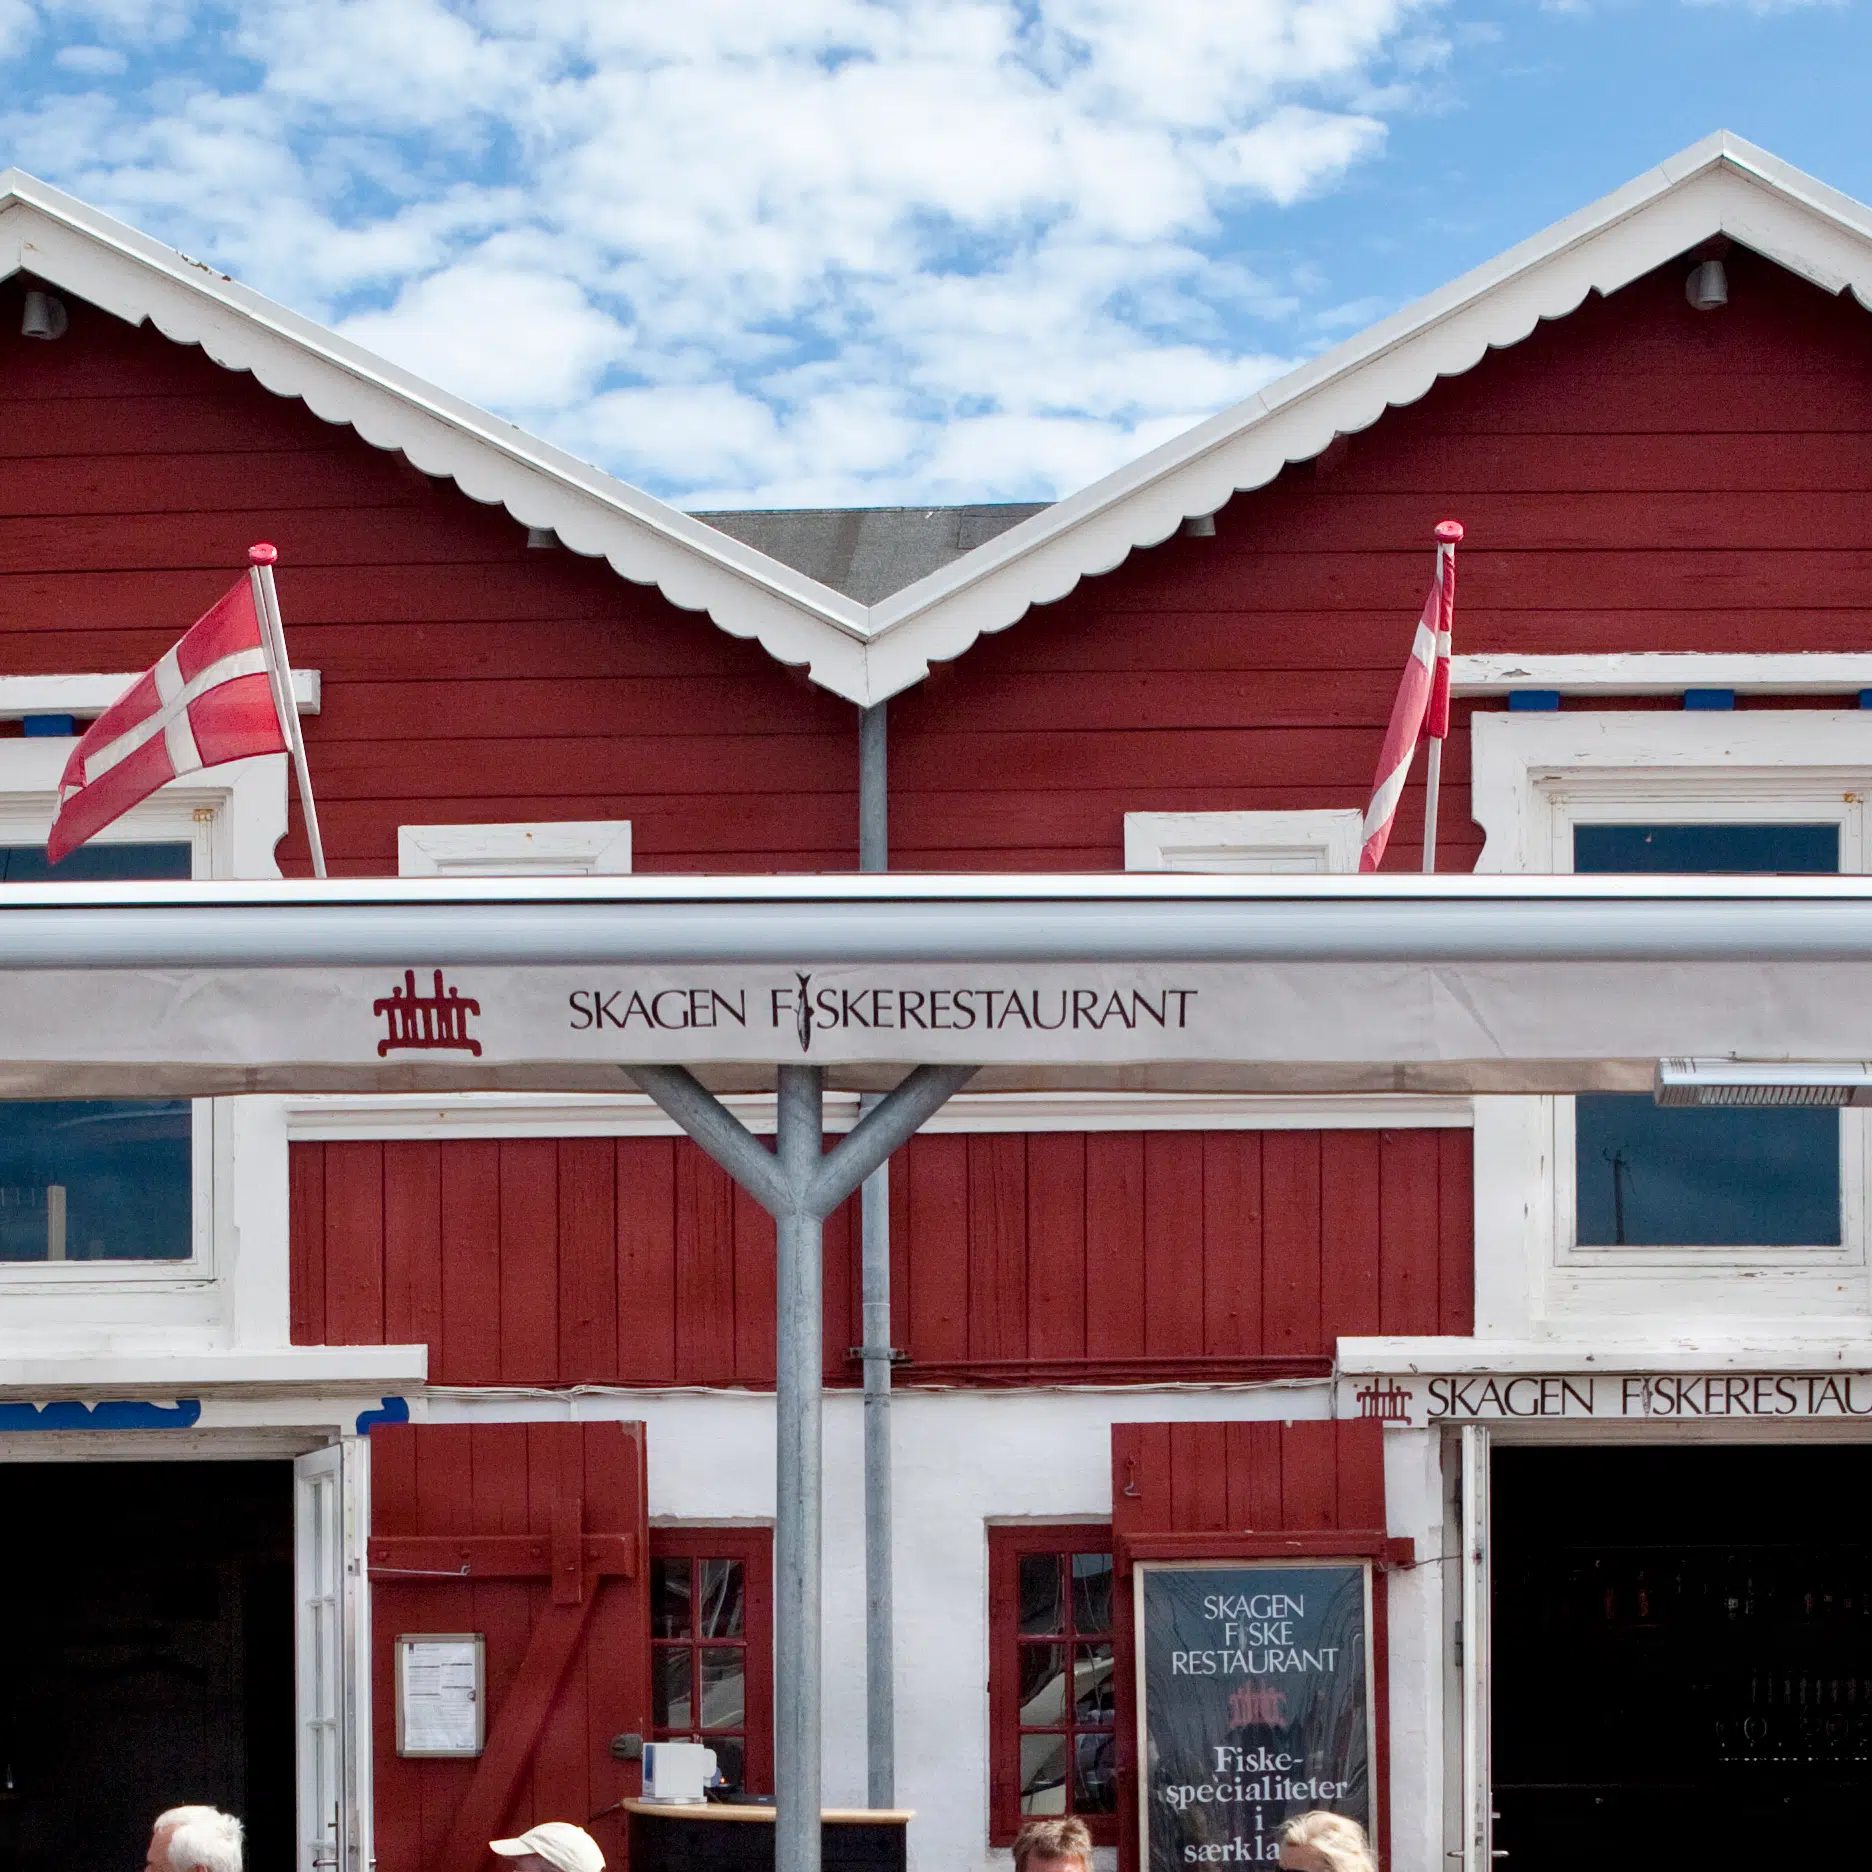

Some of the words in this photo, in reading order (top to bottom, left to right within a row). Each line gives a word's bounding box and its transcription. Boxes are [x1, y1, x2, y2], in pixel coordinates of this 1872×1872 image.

[569, 988, 746, 1030] SKAGEN
[771, 978, 1198, 1043] FISKERESTAURANT
[1427, 1377, 1594, 1418] SKAGEN
[1203, 1594, 1305, 1619] SKAGEN
[1171, 1647, 1340, 1675] RESTAURANT
[1213, 1745, 1304, 1774] Fiske-
[1165, 1774, 1349, 1811] specialiteter
[1254, 1805, 1266, 1832] i
[1183, 1835, 1280, 1863] særkla
